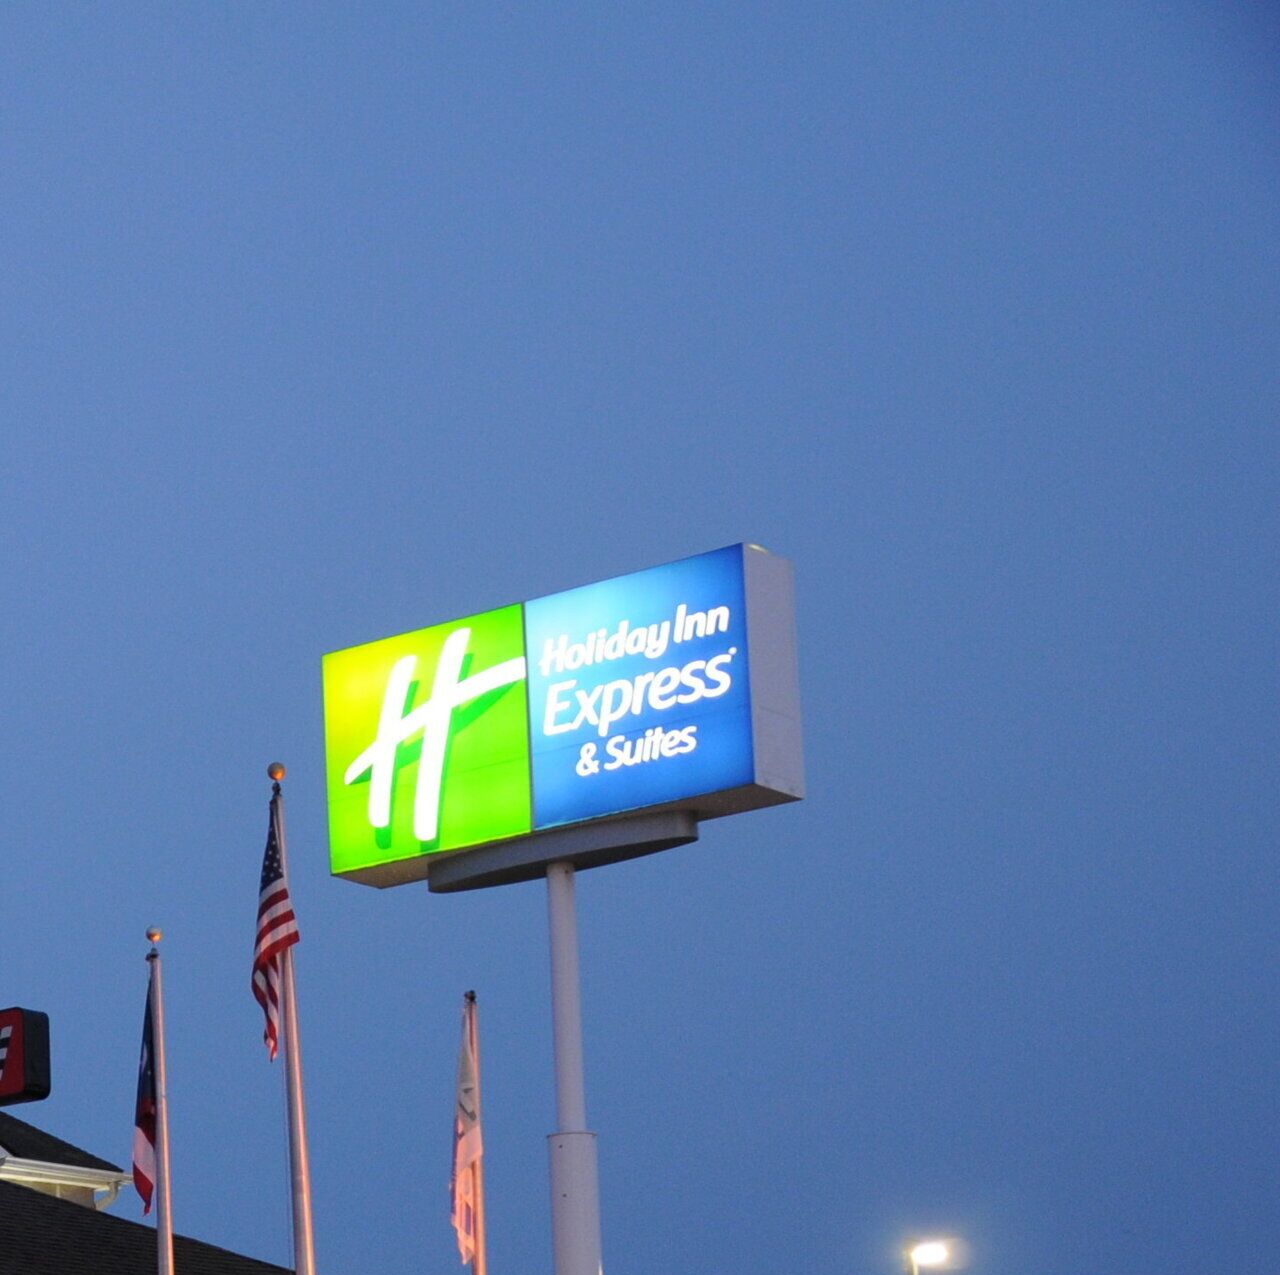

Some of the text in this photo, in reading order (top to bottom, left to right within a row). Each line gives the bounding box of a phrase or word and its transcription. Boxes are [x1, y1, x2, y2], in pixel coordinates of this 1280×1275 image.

[538, 603, 731, 677] Holiday Inn
[543, 652, 732, 737] Express
[575, 724, 698, 778] & Suites
